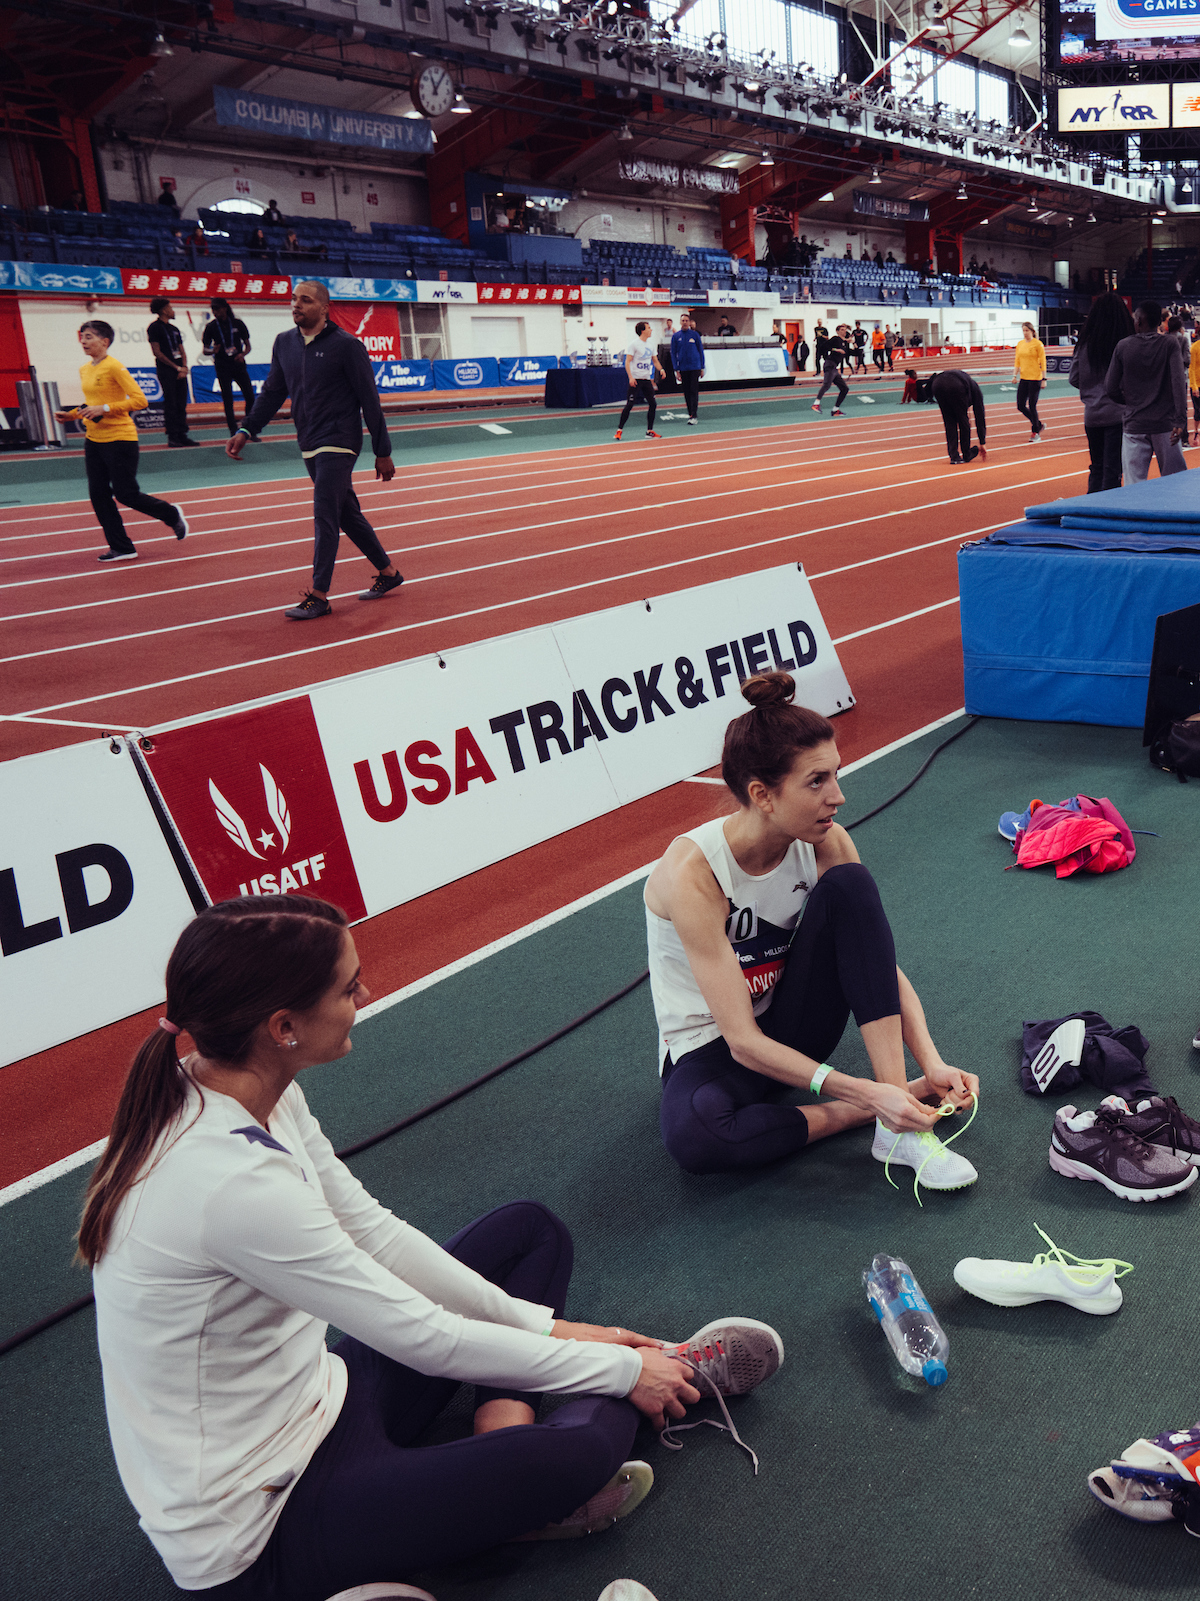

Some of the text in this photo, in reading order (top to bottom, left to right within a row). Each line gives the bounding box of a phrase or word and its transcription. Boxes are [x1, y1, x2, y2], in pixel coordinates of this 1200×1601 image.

[1144, 0, 1197, 11] GAMES
[235, 99, 413, 141] COLUMBIA UNIVERSITY
[119, 327, 186, 343] bale
[391, 364, 410, 376] The
[524, 361, 540, 371] The
[381, 375, 427, 387] Armory
[353, 619, 818, 823] USA TRACK & FIELD
[239, 852, 326, 898] USATF
